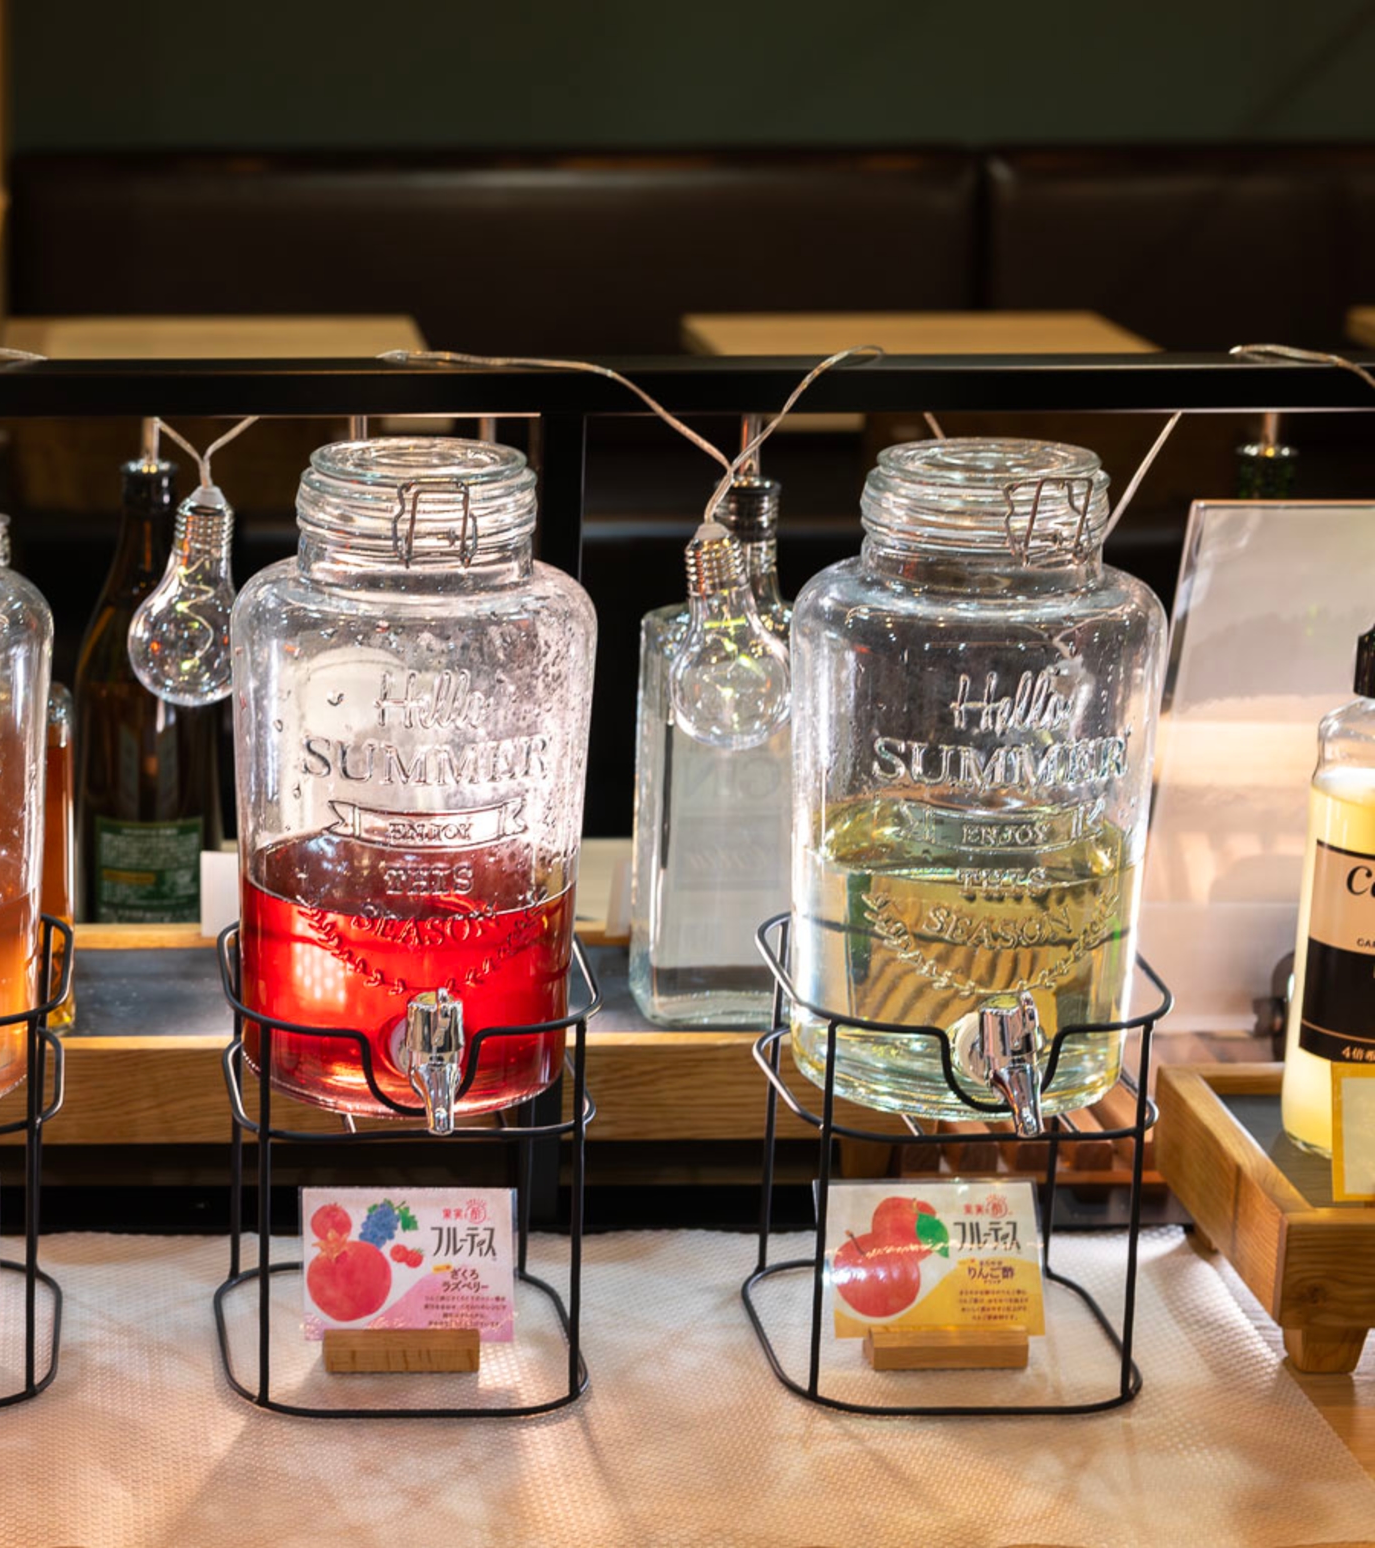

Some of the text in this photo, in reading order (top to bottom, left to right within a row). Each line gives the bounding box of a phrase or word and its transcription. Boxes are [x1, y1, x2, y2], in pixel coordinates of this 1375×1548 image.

[375, 668, 490, 730] Hello
[301, 736, 548, 787] SUMMER
[874, 736, 1127, 787] SUMMER
[388, 821, 474, 842] ENJOY
[962, 823, 1051, 845] ENJOY
[385, 862, 474, 896] THIS
[1347, 866, 1375, 898] C
[430, 1226, 497, 1257] フルーティス
[968, 1266, 1015, 1280] りんご酢
